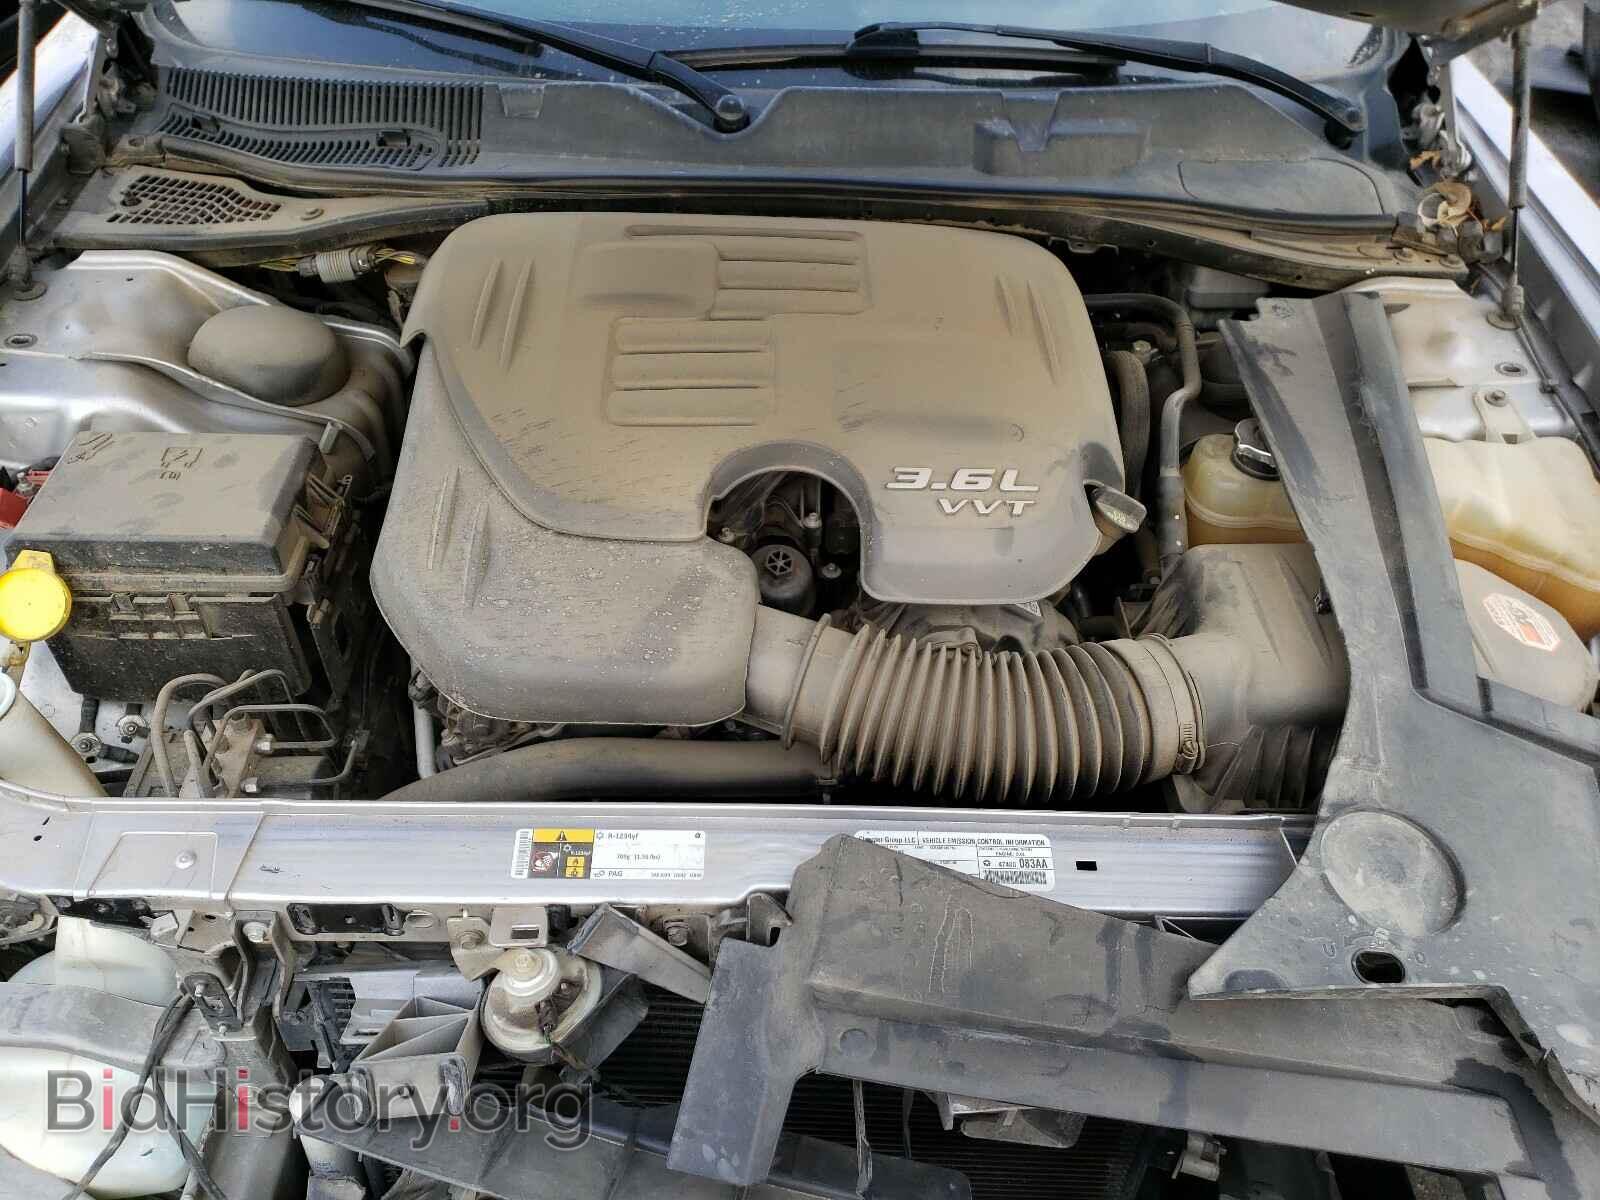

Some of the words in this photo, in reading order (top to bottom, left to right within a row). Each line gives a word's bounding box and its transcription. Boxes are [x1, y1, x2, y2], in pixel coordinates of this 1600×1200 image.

[885, 466, 1040, 492] 3.6L
[938, 498, 1036, 517] VVT
[922, 836, 945, 844] VEHICLE
[947, 837, 976, 845] EMISSION
[977, 838, 1003, 846] CONTROL
[1018, 858, 1049, 869] 083AA
[608, 869, 624, 877] PAG
